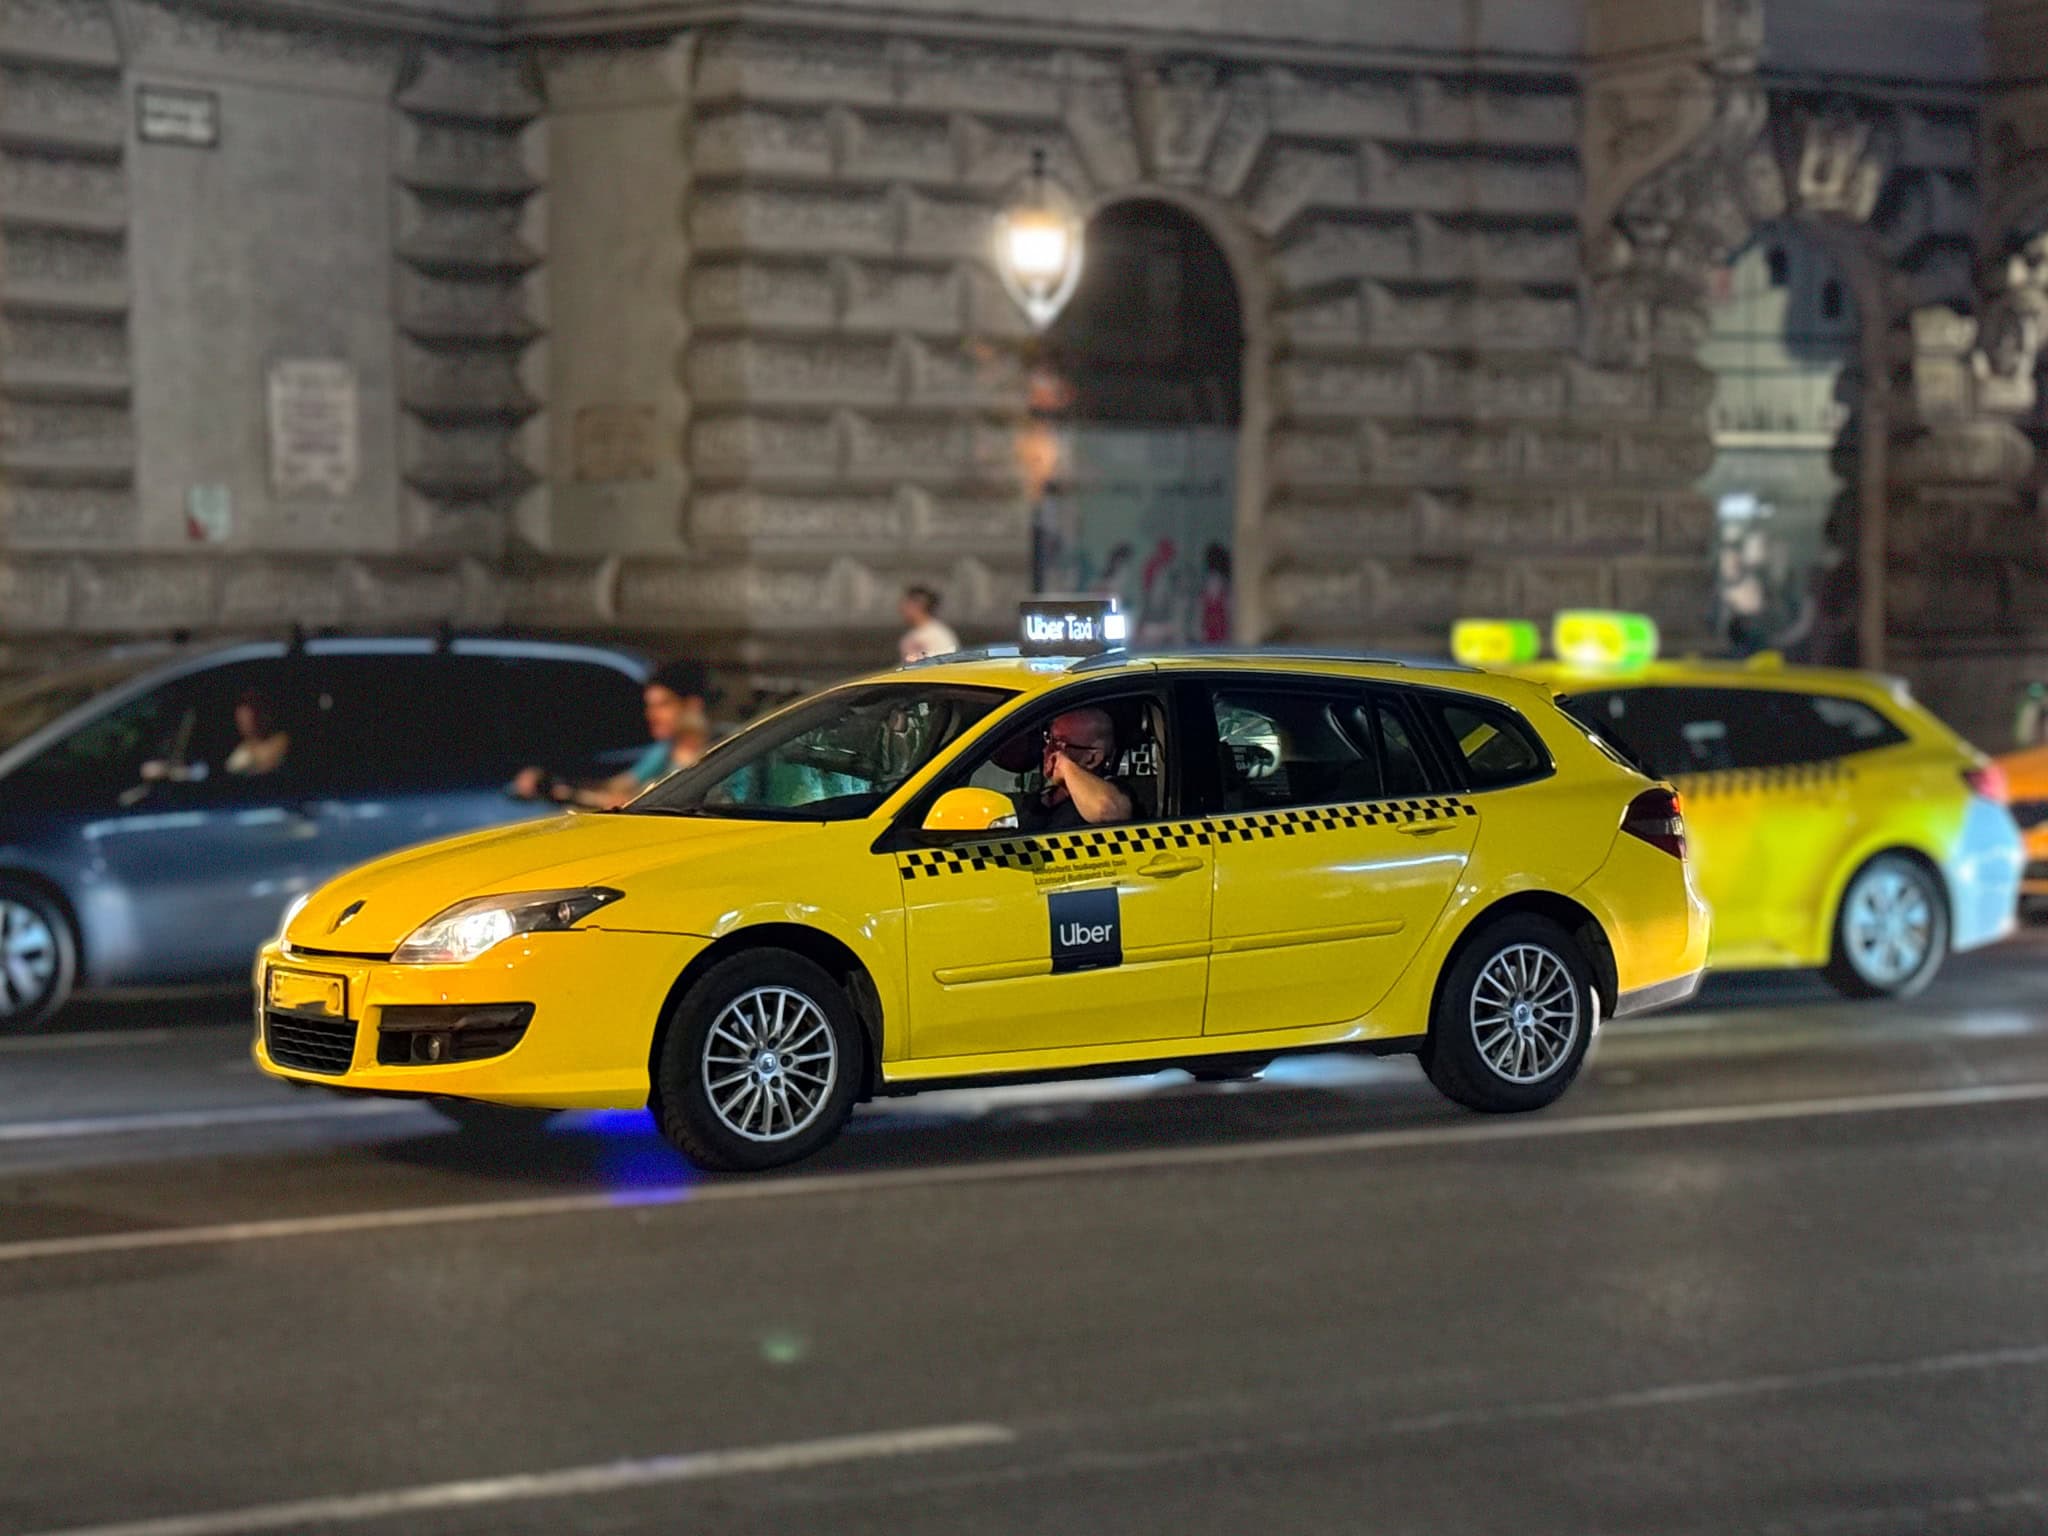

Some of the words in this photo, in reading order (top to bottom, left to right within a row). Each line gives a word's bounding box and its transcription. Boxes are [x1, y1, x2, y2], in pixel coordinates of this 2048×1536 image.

[1026, 615, 1064, 640] Uber
[1064, 614, 1093, 640] Taxi
[1059, 922, 1113, 947] Uber
